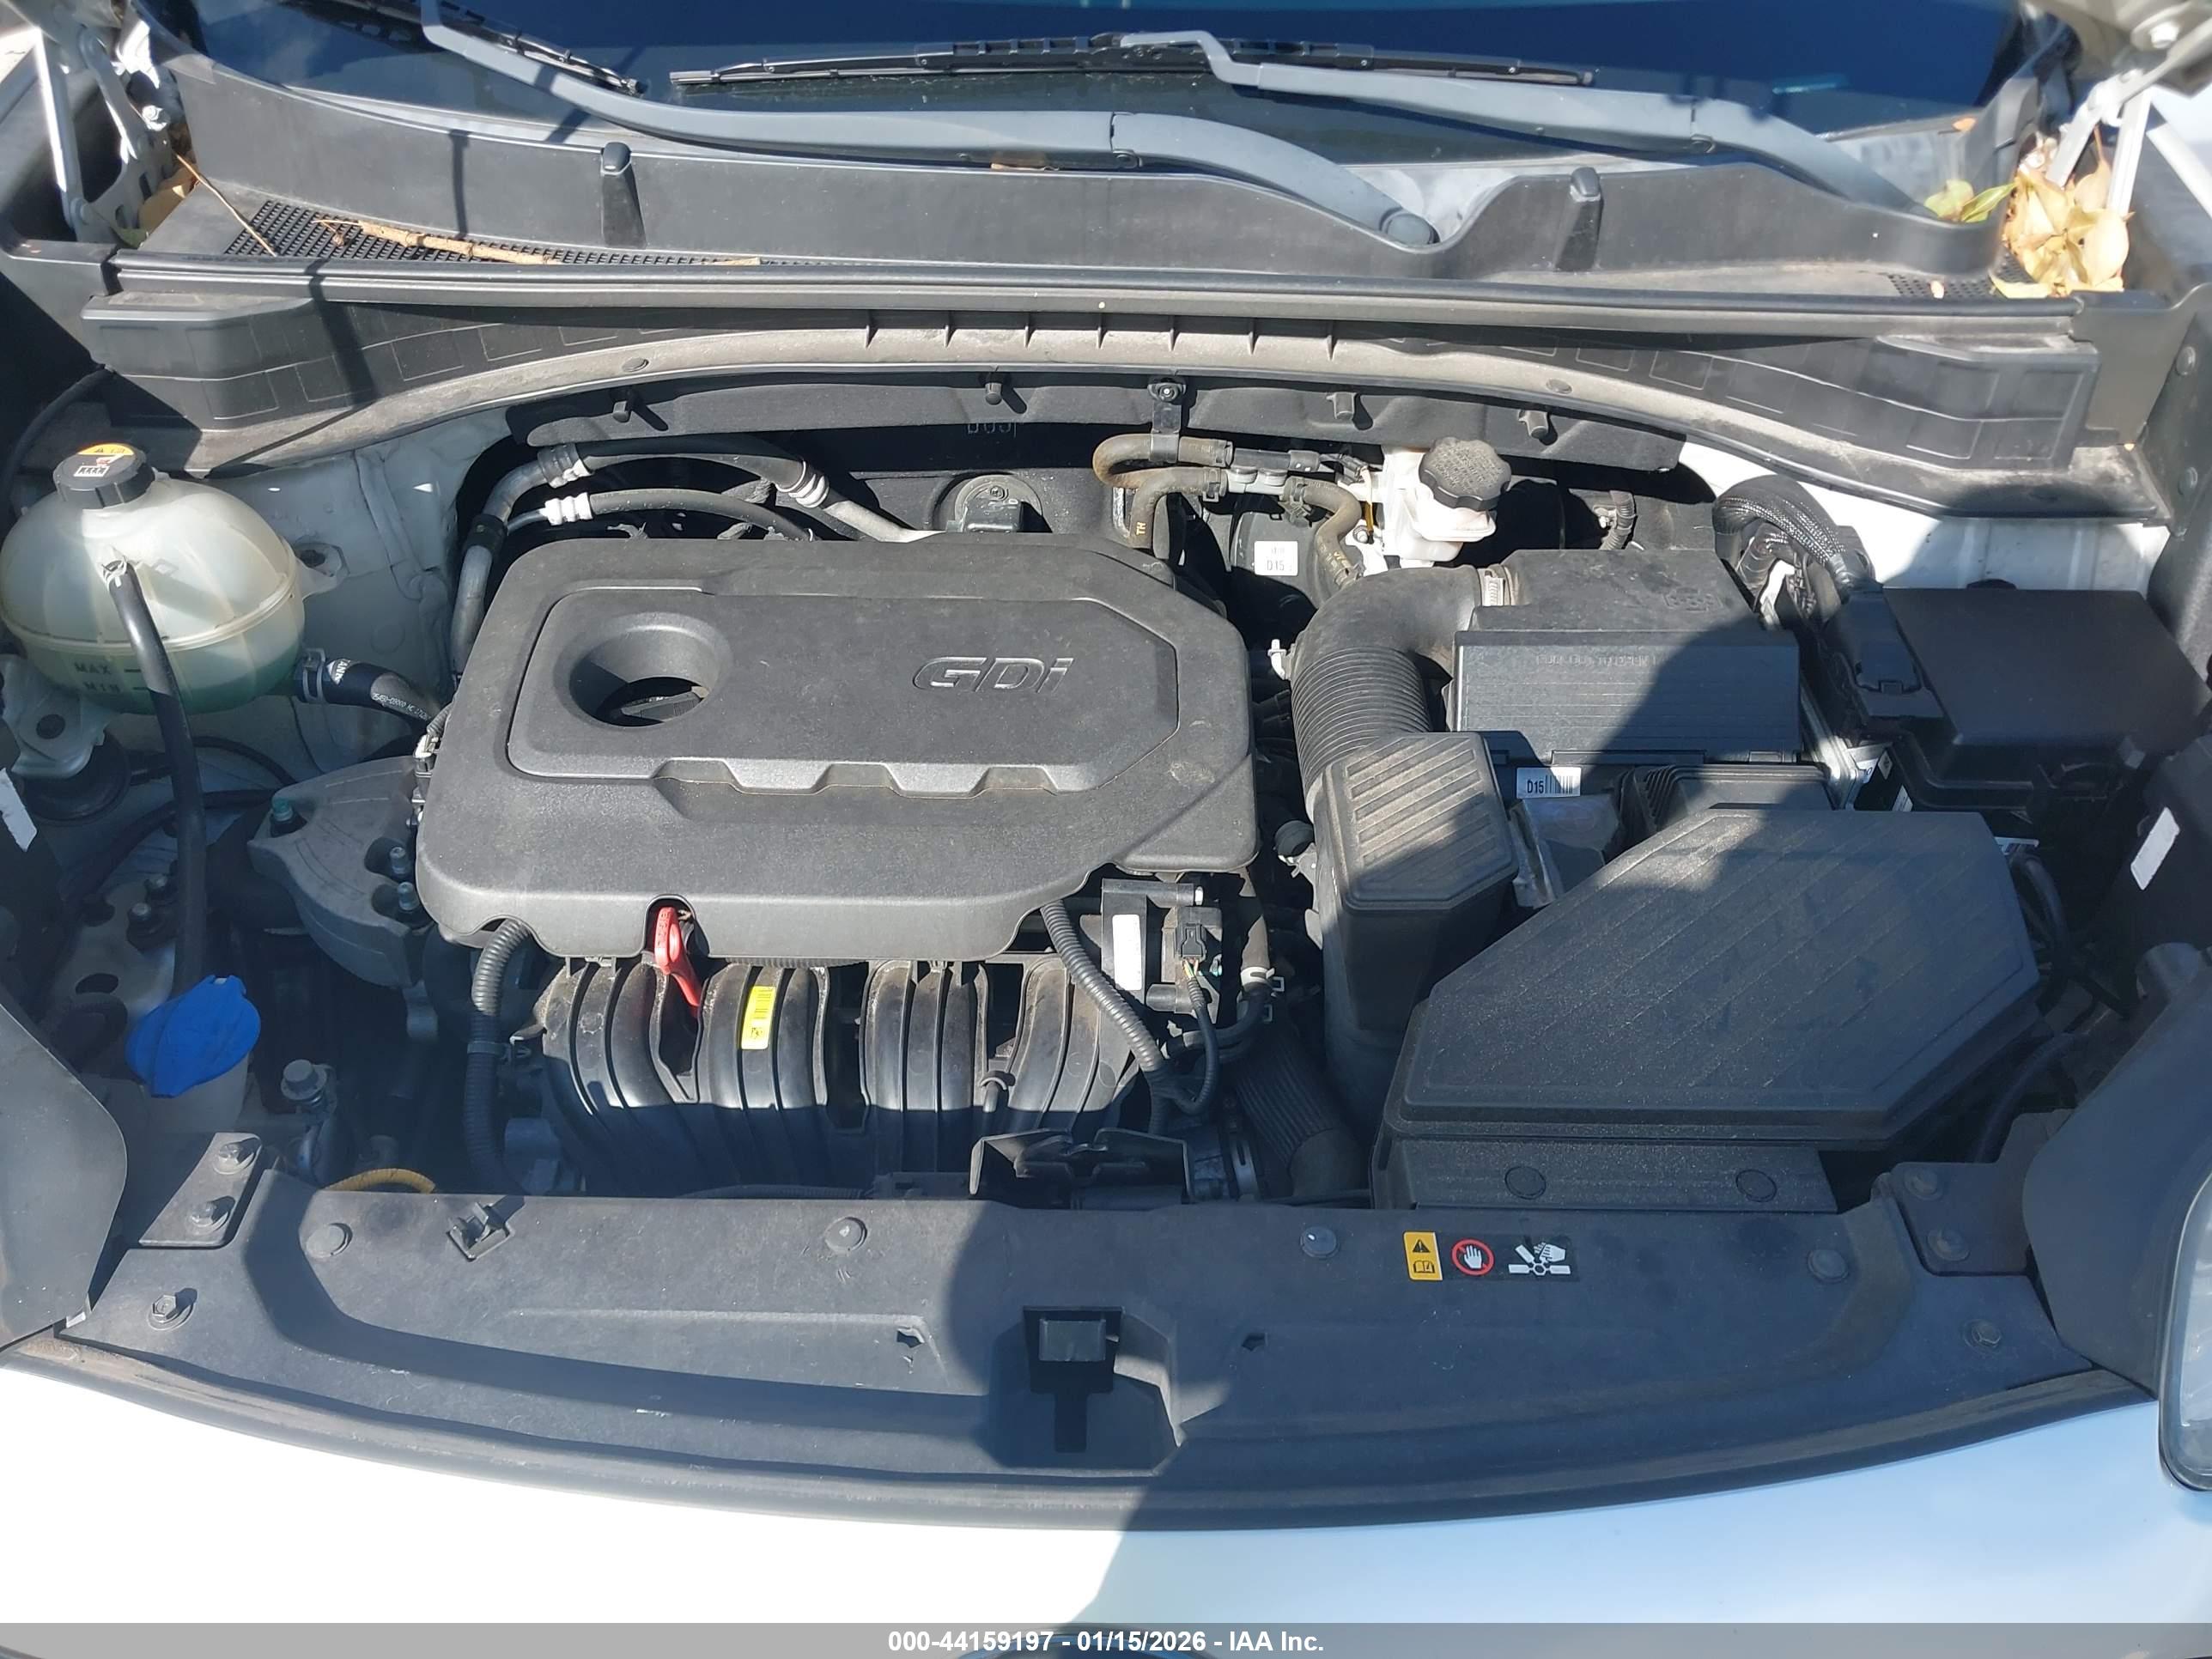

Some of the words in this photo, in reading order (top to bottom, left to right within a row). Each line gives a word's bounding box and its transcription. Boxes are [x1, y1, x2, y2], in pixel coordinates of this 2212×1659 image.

[1267, 559, 1285, 571] D15
[74, 662, 112, 675] MAX
[913, 656, 1074, 693] GDi
[1527, 780, 1544, 793] D15
